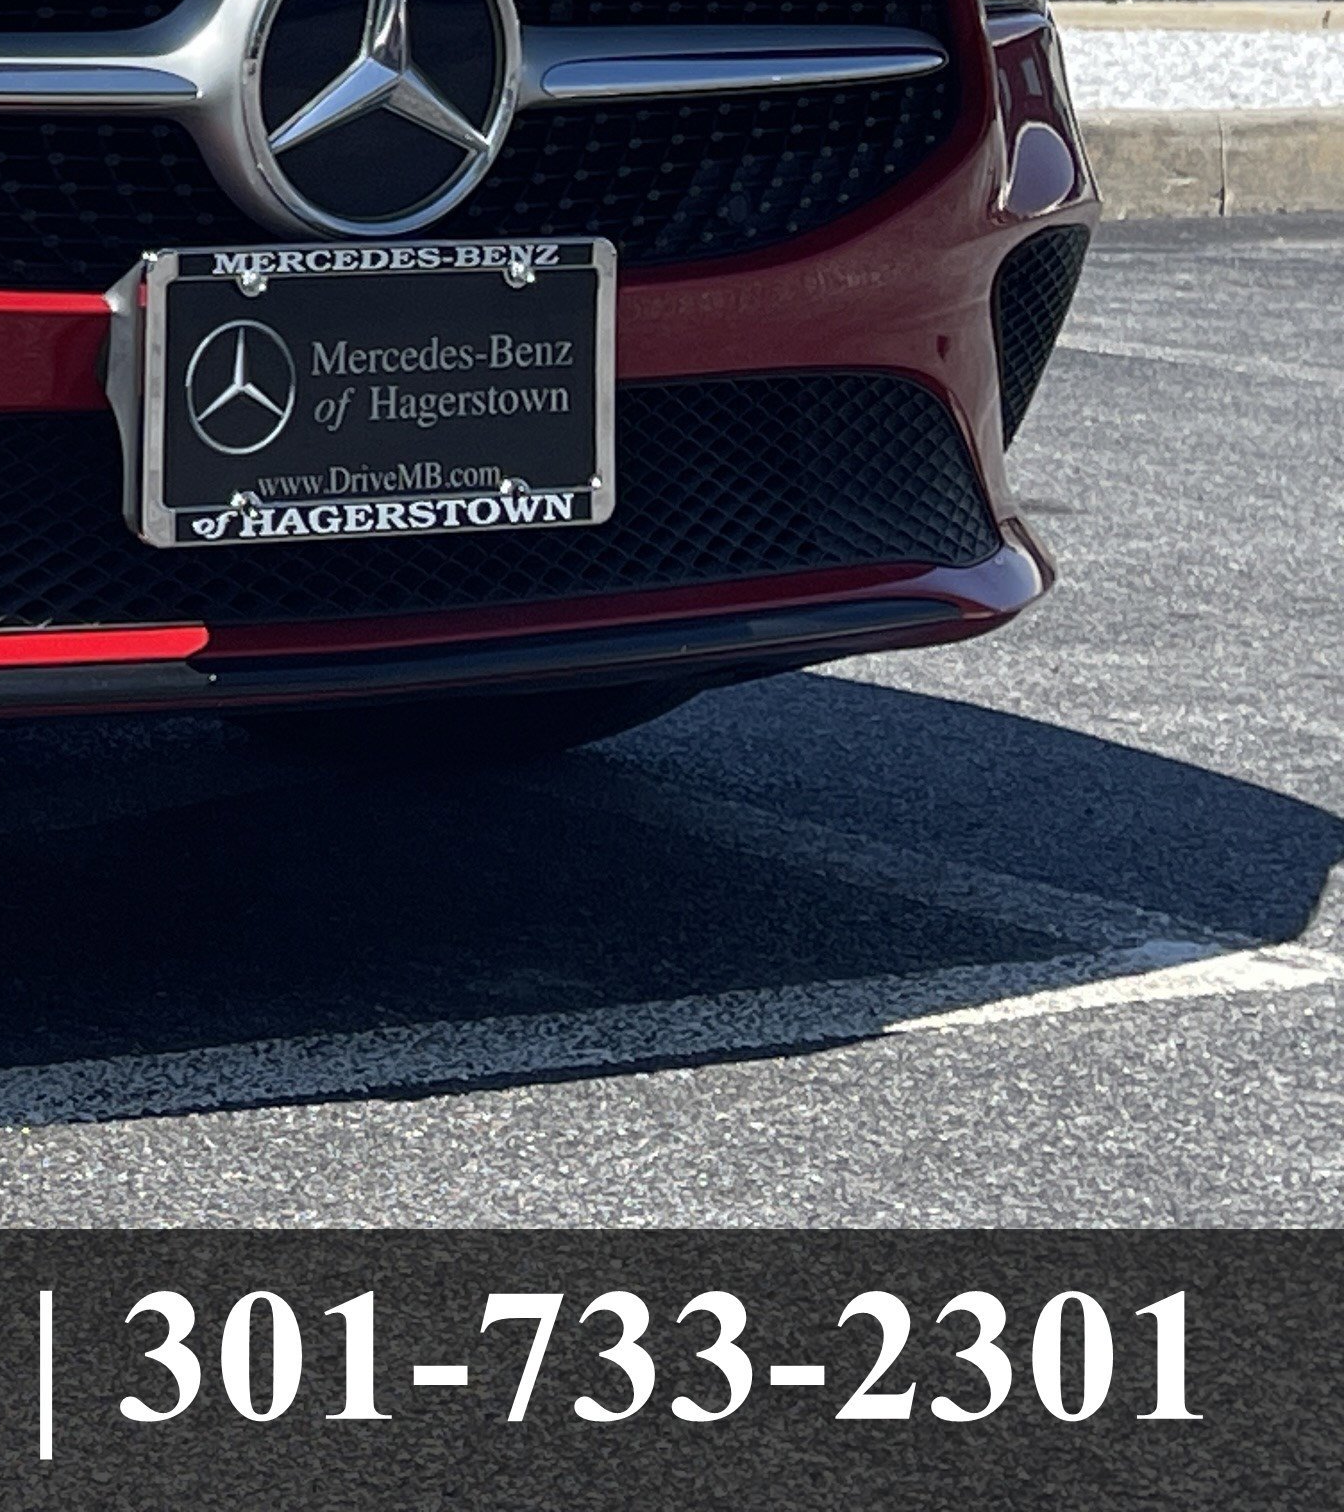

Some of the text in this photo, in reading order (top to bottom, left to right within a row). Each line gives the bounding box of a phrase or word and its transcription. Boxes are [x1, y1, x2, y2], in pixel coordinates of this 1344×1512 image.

[212, 244, 560, 276] MERCEDES-BENZ
[311, 334, 573, 377] Mercedes-Benz
[314, 384, 570, 431] of Hagerstown
[257, 462, 502, 497] www.DriveMB.com
[192, 492, 575, 539] of HAGERSTOWN
